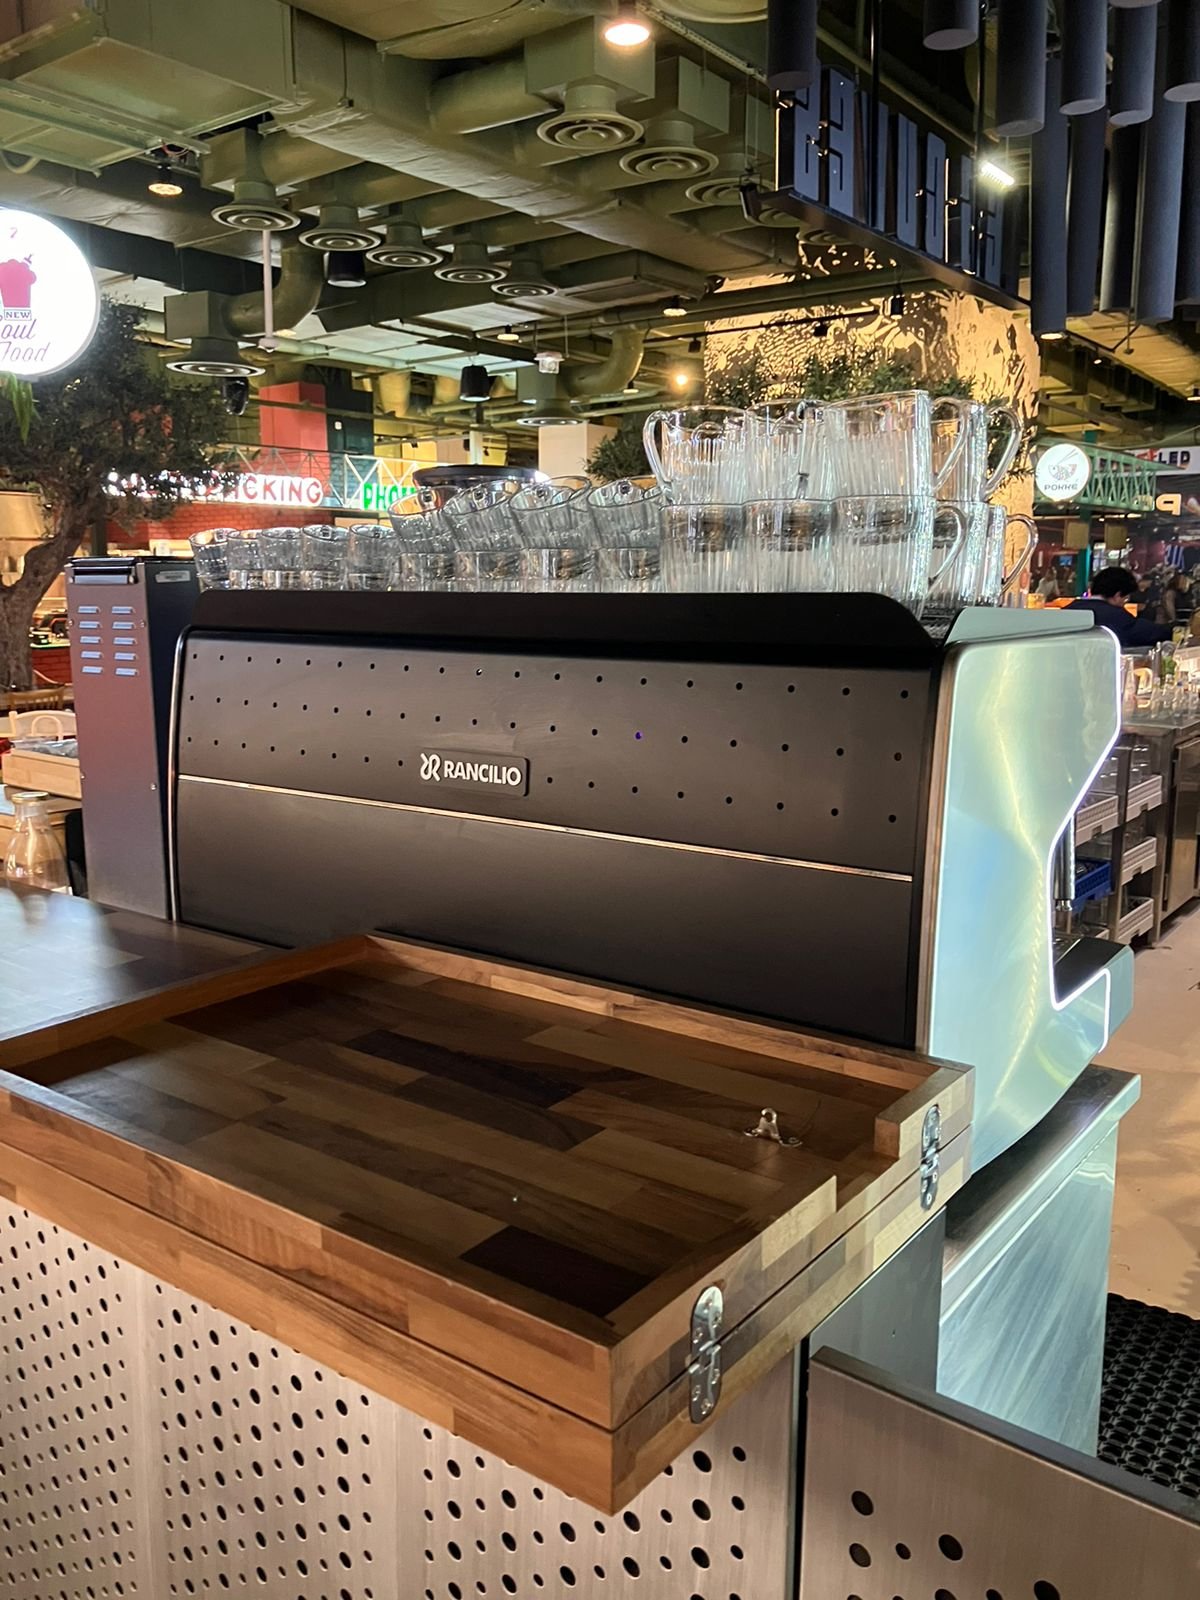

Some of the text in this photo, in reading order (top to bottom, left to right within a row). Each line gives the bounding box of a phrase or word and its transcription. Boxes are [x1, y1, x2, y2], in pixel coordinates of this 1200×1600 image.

[0, 314, 37, 340] oul
[5, 311, 31, 319] NEW
[443, 760, 522, 786] RANCILIO
